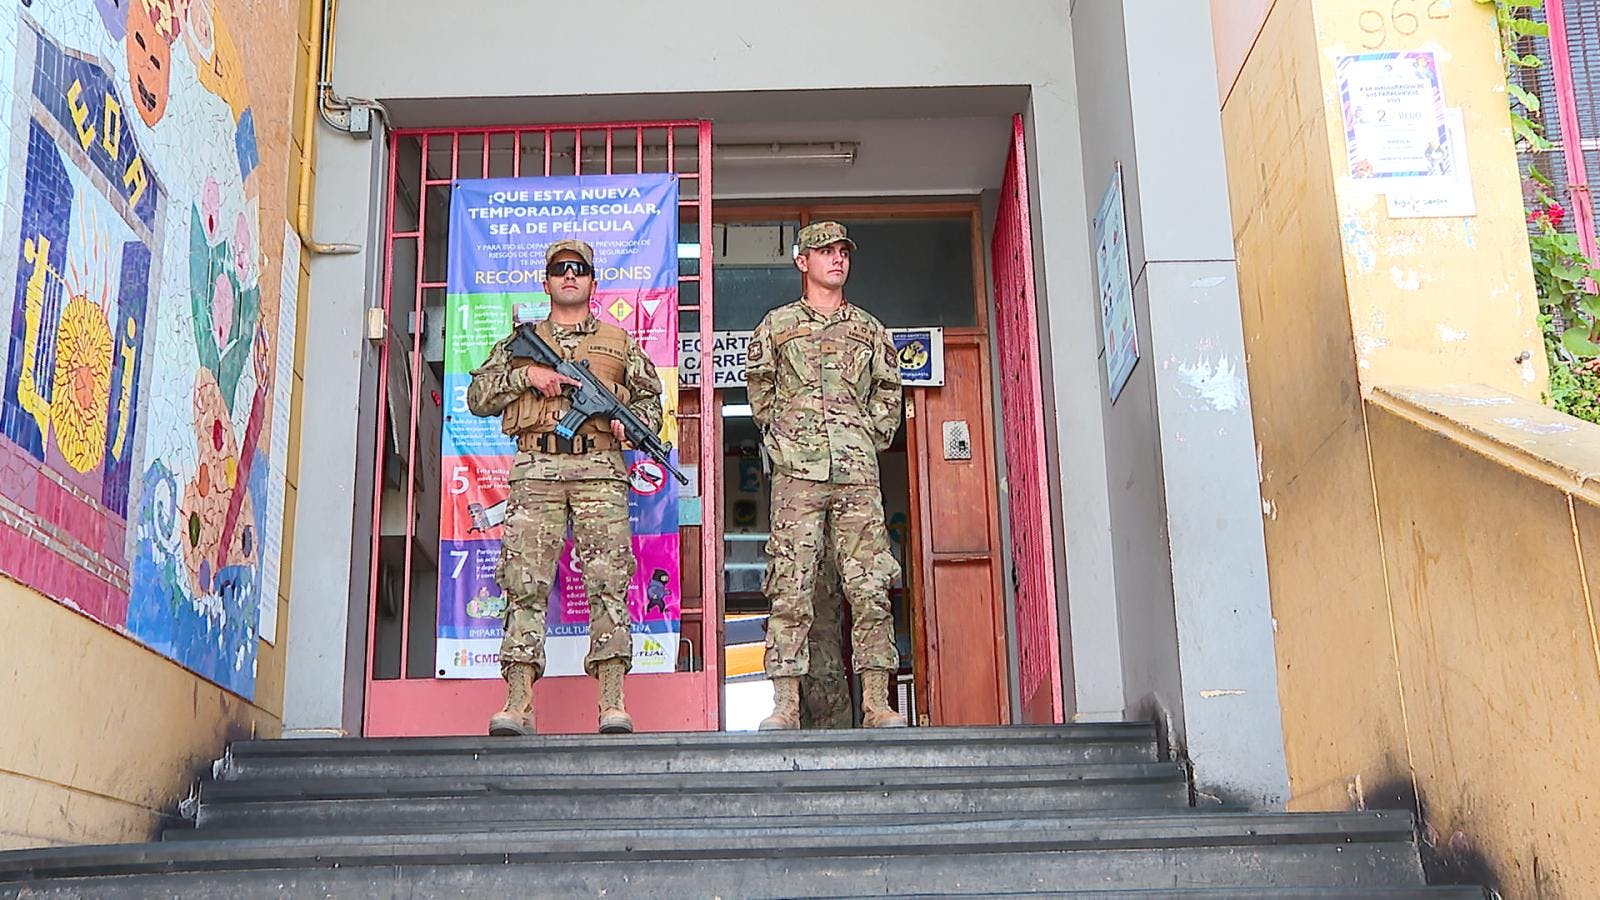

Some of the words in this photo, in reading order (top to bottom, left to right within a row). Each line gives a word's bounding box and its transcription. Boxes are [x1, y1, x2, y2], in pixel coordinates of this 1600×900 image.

[488, 191, 529, 205] ¡QUE
[534, 190, 576, 202] ESTA
[581, 187, 641, 200] NUEVA
[468, 205, 576, 219] TEMPORADA
[580, 203, 661, 216] ESCOLAR,
[489, 223, 521, 235] SEA
[526, 222, 548, 234] DE
[553, 218, 635, 233] PELÍCULA
[457, 304, 469, 330] 1
[452, 386, 469, 413] 3
[451, 466, 470, 495] 5
[450, 551, 469, 580] 7
[569, 547, 583, 574] 8
